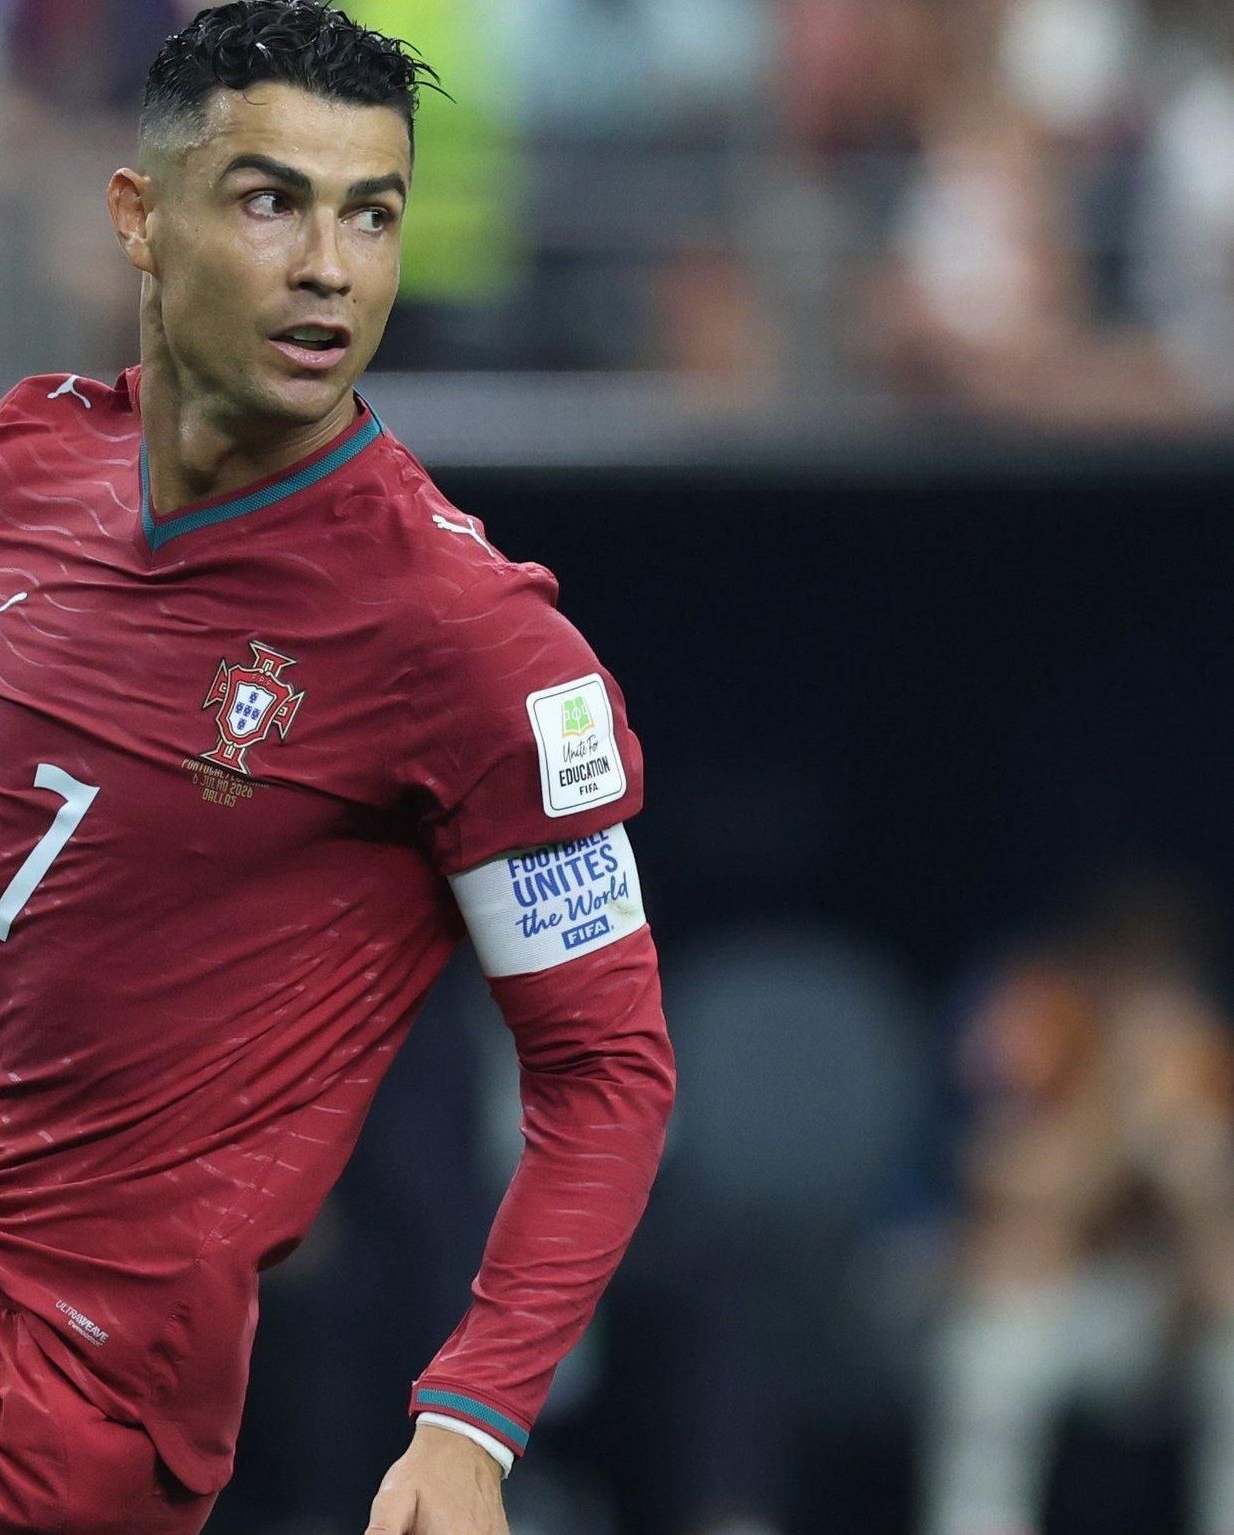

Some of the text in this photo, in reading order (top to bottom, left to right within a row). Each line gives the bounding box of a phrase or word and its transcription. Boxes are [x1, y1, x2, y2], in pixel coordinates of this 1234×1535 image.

[562, 740, 586, 764] Unite
[559, 755, 611, 787] EDUCATION
[192, 773, 199, 784] 6
[230, 782, 253, 799] 2026
[202, 788, 237, 807] DALLAS
[579, 782, 599, 796] FIFA
[512, 843, 618, 908] UNITES
[515, 871, 629, 939] the World
[565, 920, 608, 945] FIFA
[55, 1299, 109, 1343] ULTRAWEAVE
